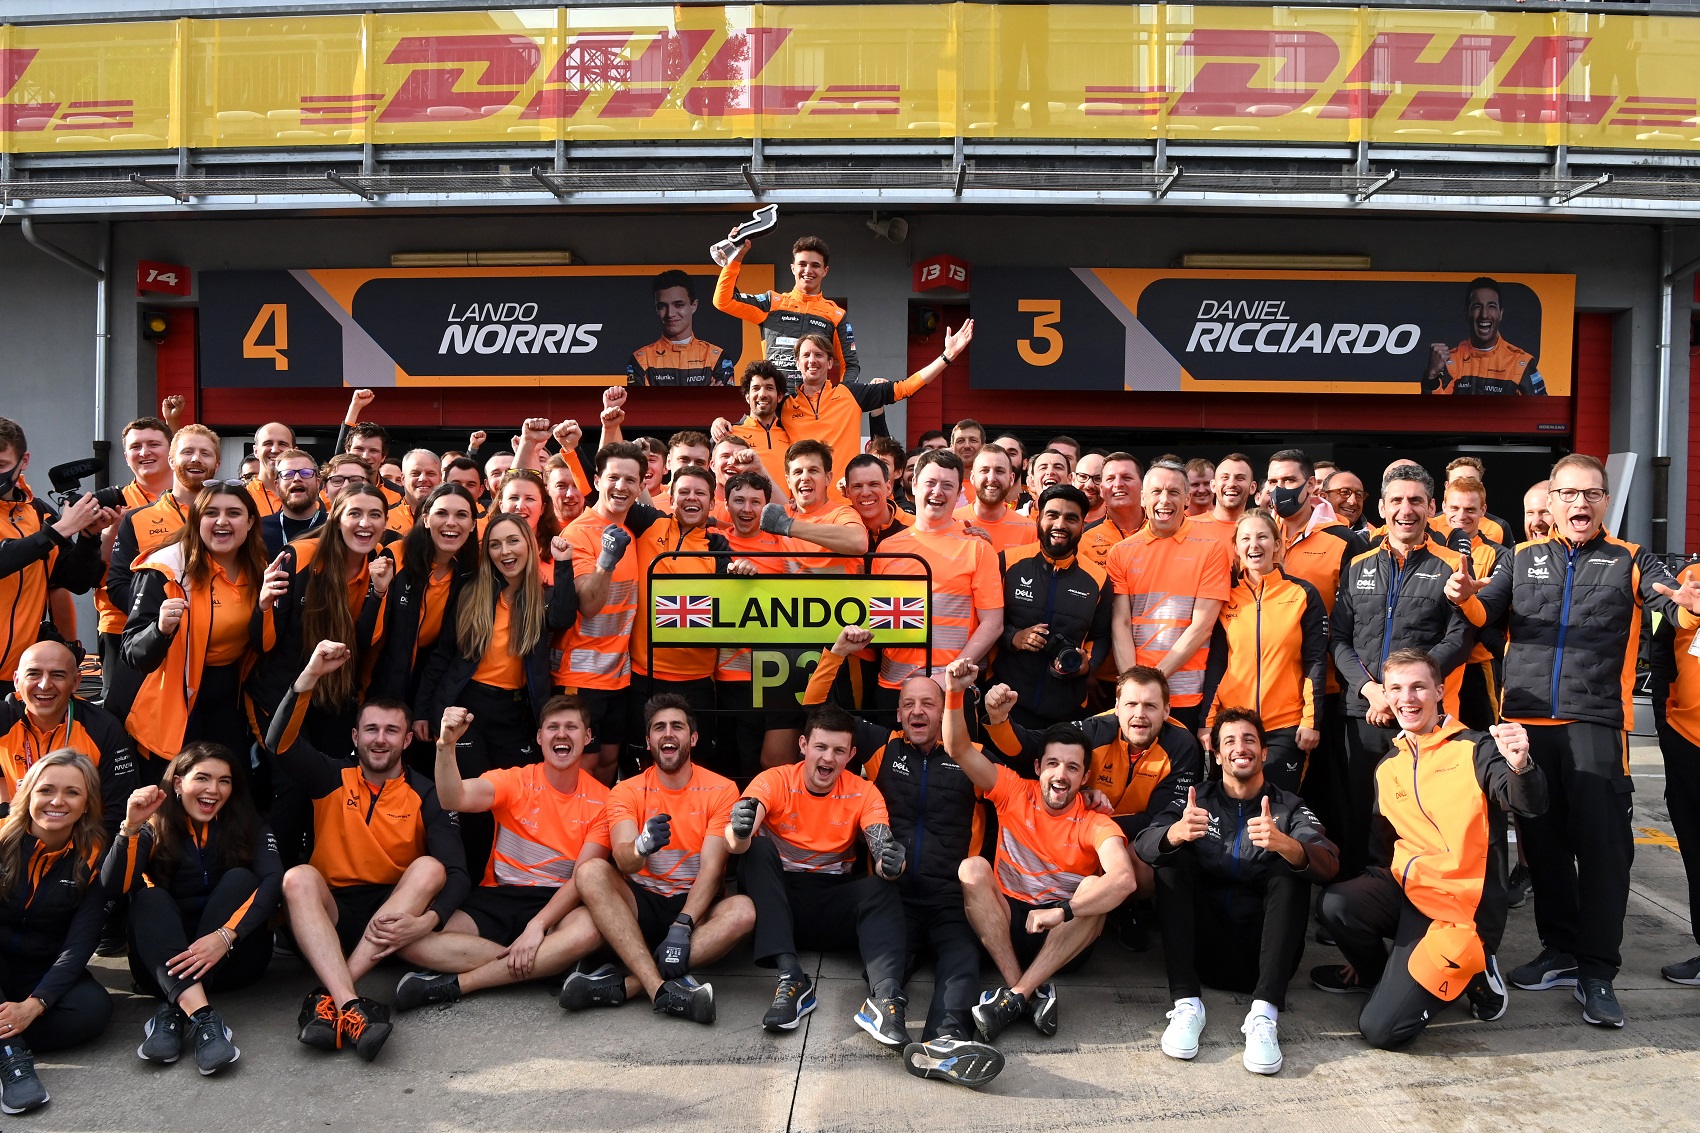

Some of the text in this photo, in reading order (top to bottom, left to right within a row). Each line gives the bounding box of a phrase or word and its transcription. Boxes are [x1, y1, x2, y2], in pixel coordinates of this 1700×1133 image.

[375, 28, 819, 123] DHL
[1167, 28, 1618, 124] DHL
[146, 269, 179, 286] 14
[921, 264, 941, 282] 13
[948, 264, 966, 282] 13
[448, 302, 538, 322] LANDO
[1197, 300, 1290, 320] DANIEL
[243, 304, 288, 370] 4
[438, 324, 603, 354] NORRIS
[1017, 299, 1063, 366] 3
[1185, 322, 1421, 354] RICCIARDO
[62, 462, 93, 478] RØDE
[1015, 588, 1034, 598] DELL
[712, 597, 866, 628] LANDO
[893, 761, 910, 772] DELL
[1439, 981, 1448, 996] 4
